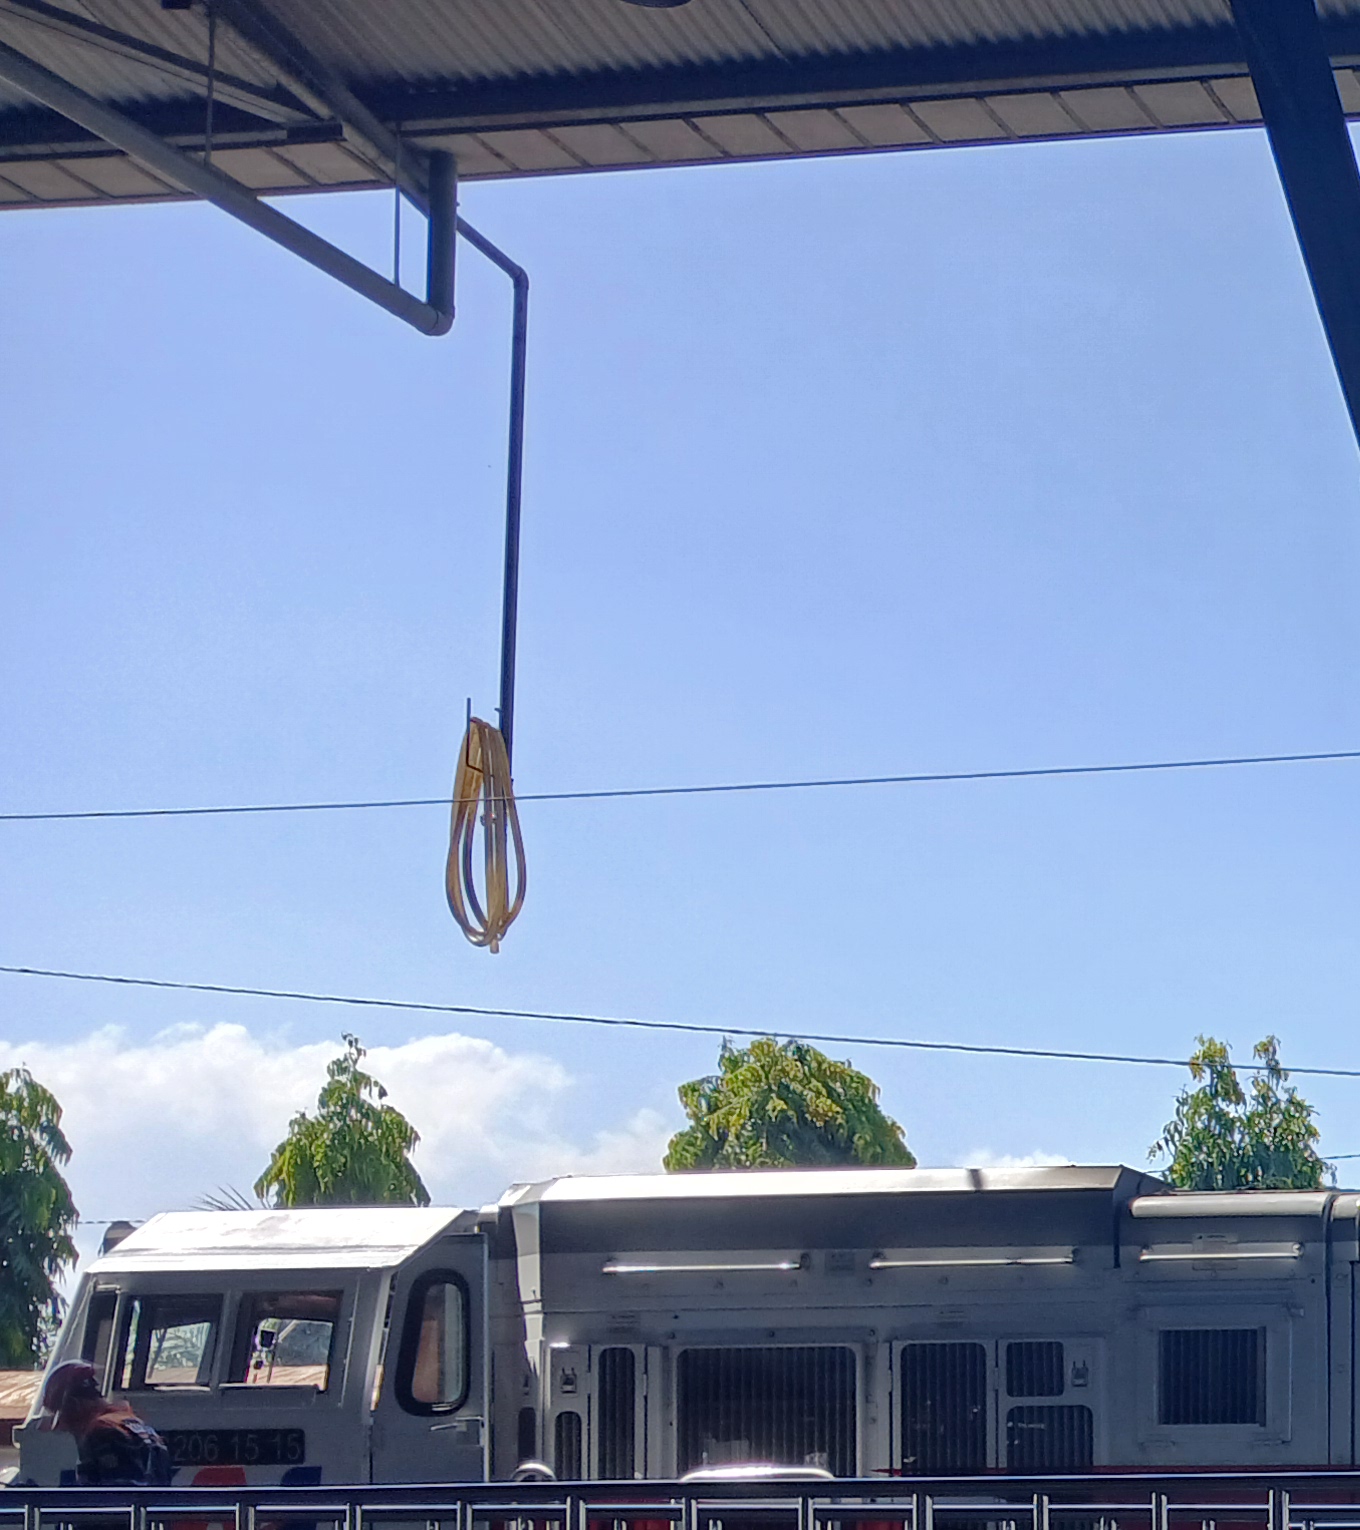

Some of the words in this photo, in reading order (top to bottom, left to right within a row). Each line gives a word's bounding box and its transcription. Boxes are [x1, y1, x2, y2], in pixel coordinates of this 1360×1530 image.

[174, 1434, 218, 1462] 206
[231, 1434, 260, 1461] 15
[272, 1432, 301, 1460] 15
